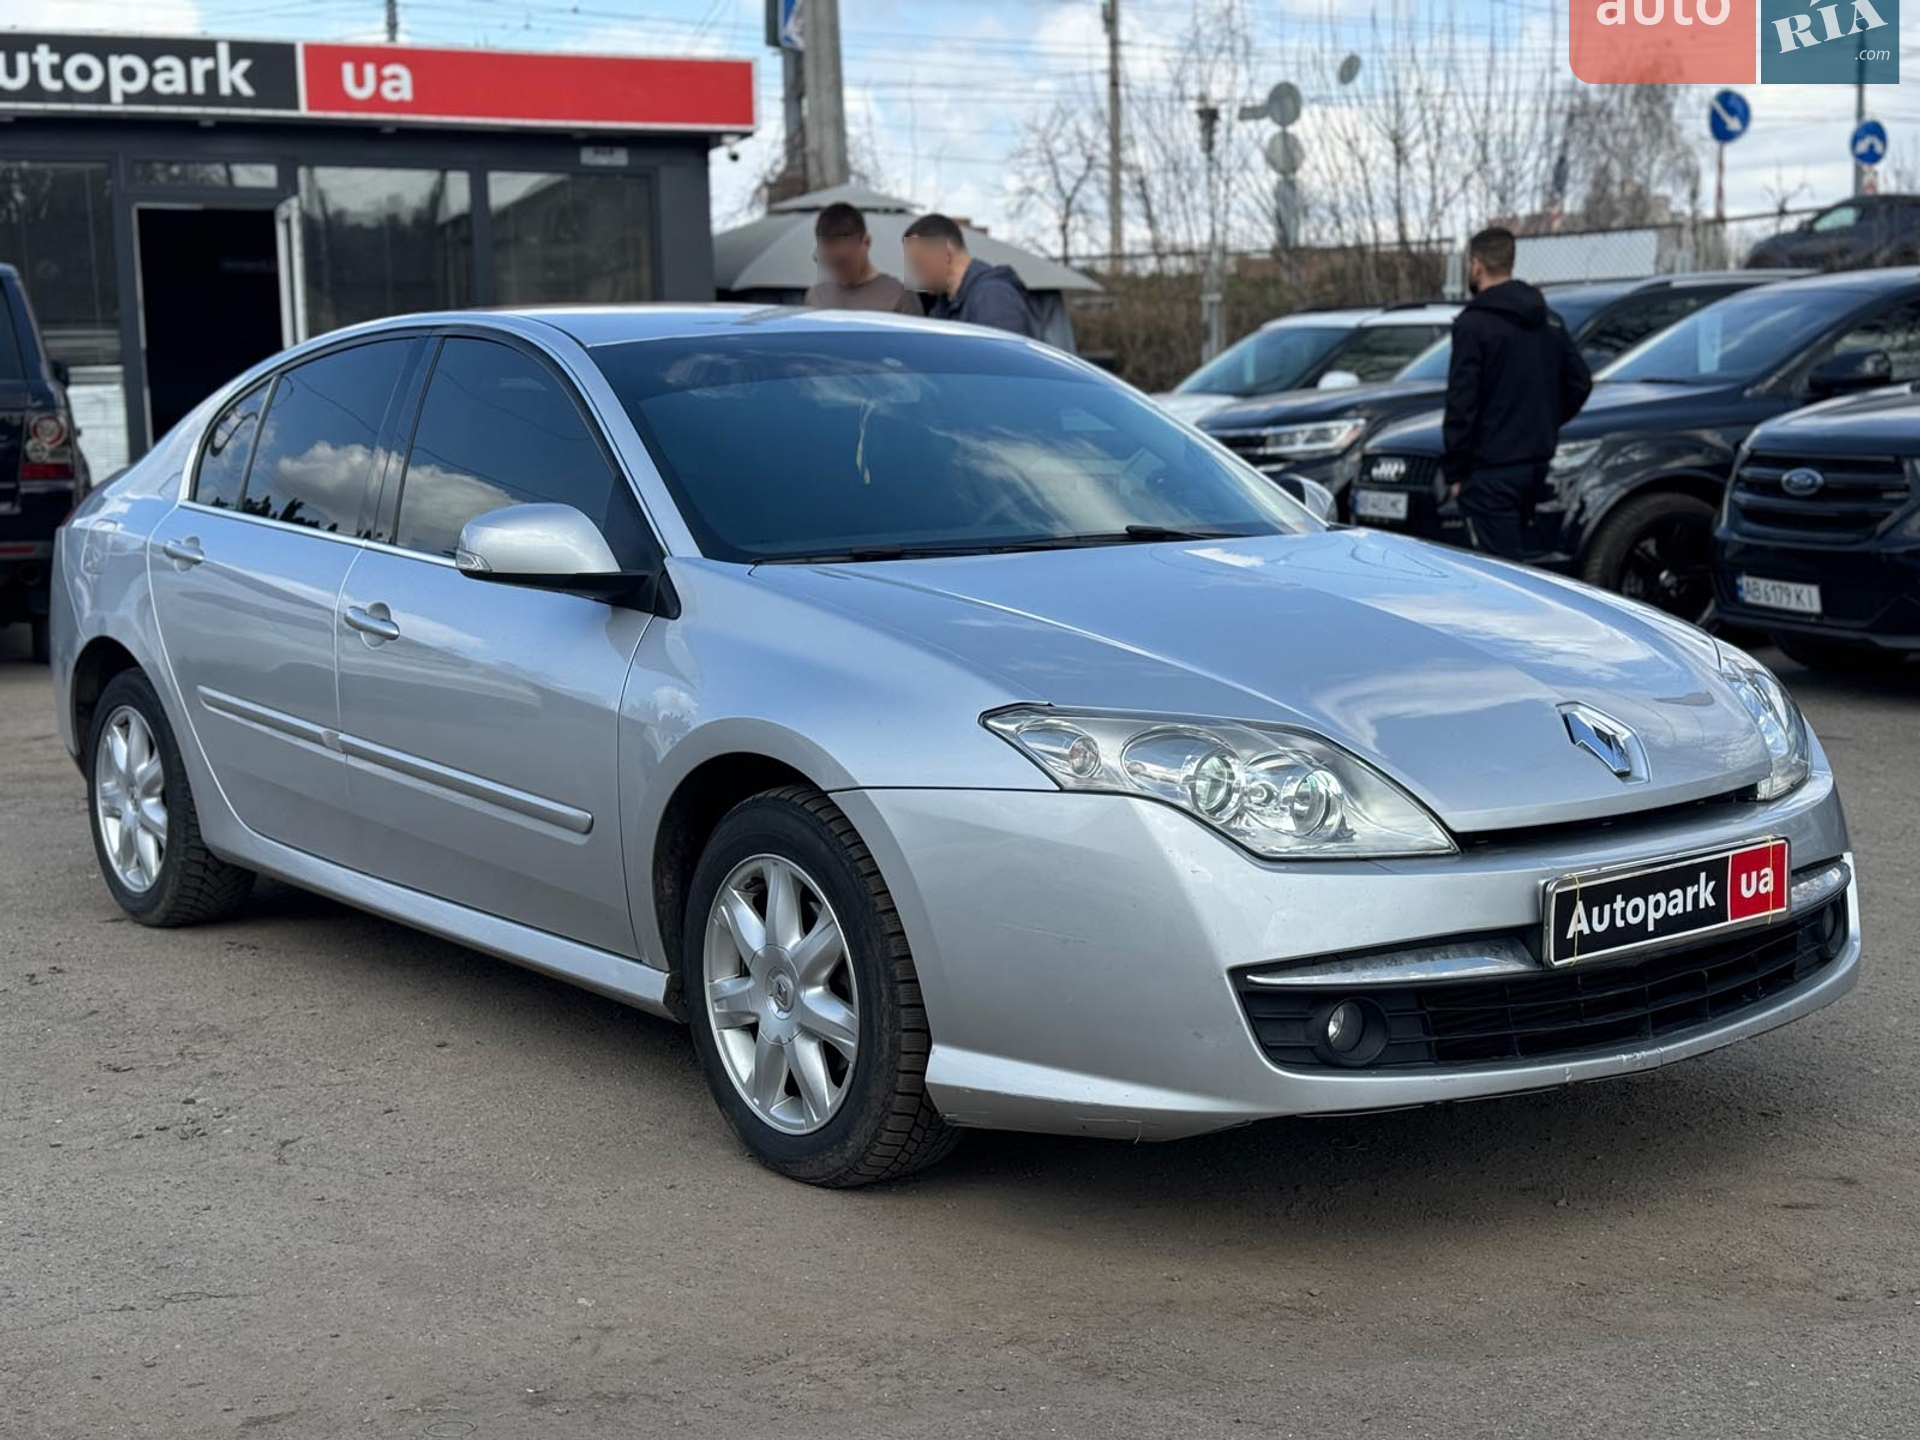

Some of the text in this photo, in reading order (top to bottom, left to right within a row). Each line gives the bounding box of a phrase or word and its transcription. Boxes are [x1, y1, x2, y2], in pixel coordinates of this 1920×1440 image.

[0, 42, 414, 104] utopark ua
[1565, 866, 1774, 940] Autopark ua
